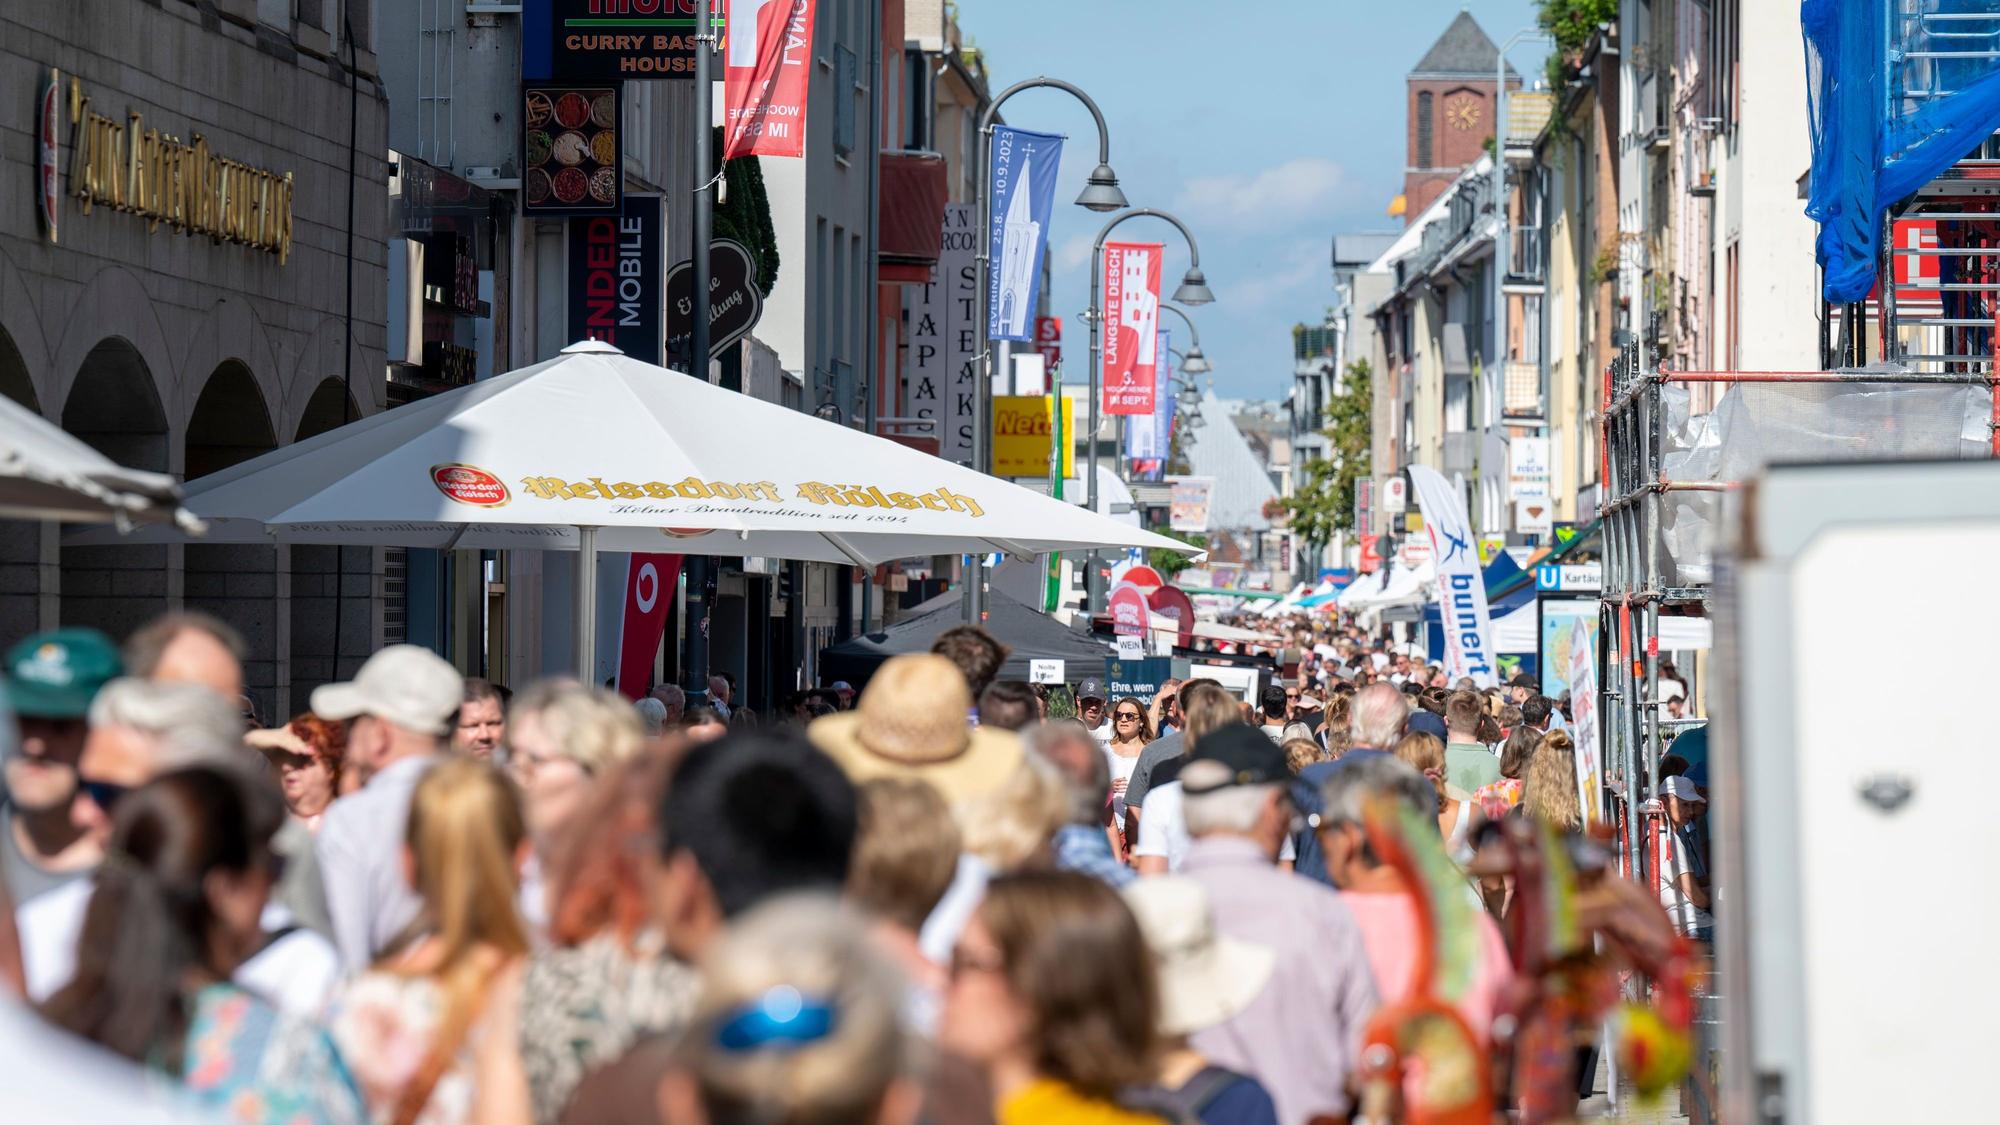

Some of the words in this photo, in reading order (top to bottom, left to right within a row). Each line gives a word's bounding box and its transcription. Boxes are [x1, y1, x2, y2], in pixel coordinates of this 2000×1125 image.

[565, 35, 645, 50] CURRY
[996, 131, 1014, 196] 10.9.2023
[992, 211, 1004, 244] 25.8.
[619, 216, 642, 327] MOBILE
[1108, 248, 1121, 294] DESCH
[990, 255, 1001, 336] SEVERINALE
[1105, 300, 1120, 366] LÄNGSTE
[915, 282, 938, 432] TAPAS
[1121, 395, 1150, 406] SEPT.
[520, 476, 784, 502] Reissdorf
[796, 481, 985, 518] Kölsch
[608, 504, 680, 515] Kölner
[683, 504, 822, 519] Brautradition
[828, 512, 858, 522] seit
[865, 513, 909, 524] 1894
[1540, 568, 1558, 588] U
[1564, 572, 1600, 583] Kartäu
[1119, 640, 1140, 650] WEIN
[1450, 574, 1491, 676] bunert
[1111, 681, 1132, 694] Ehre,
[1133, 683, 1154, 693] wem
